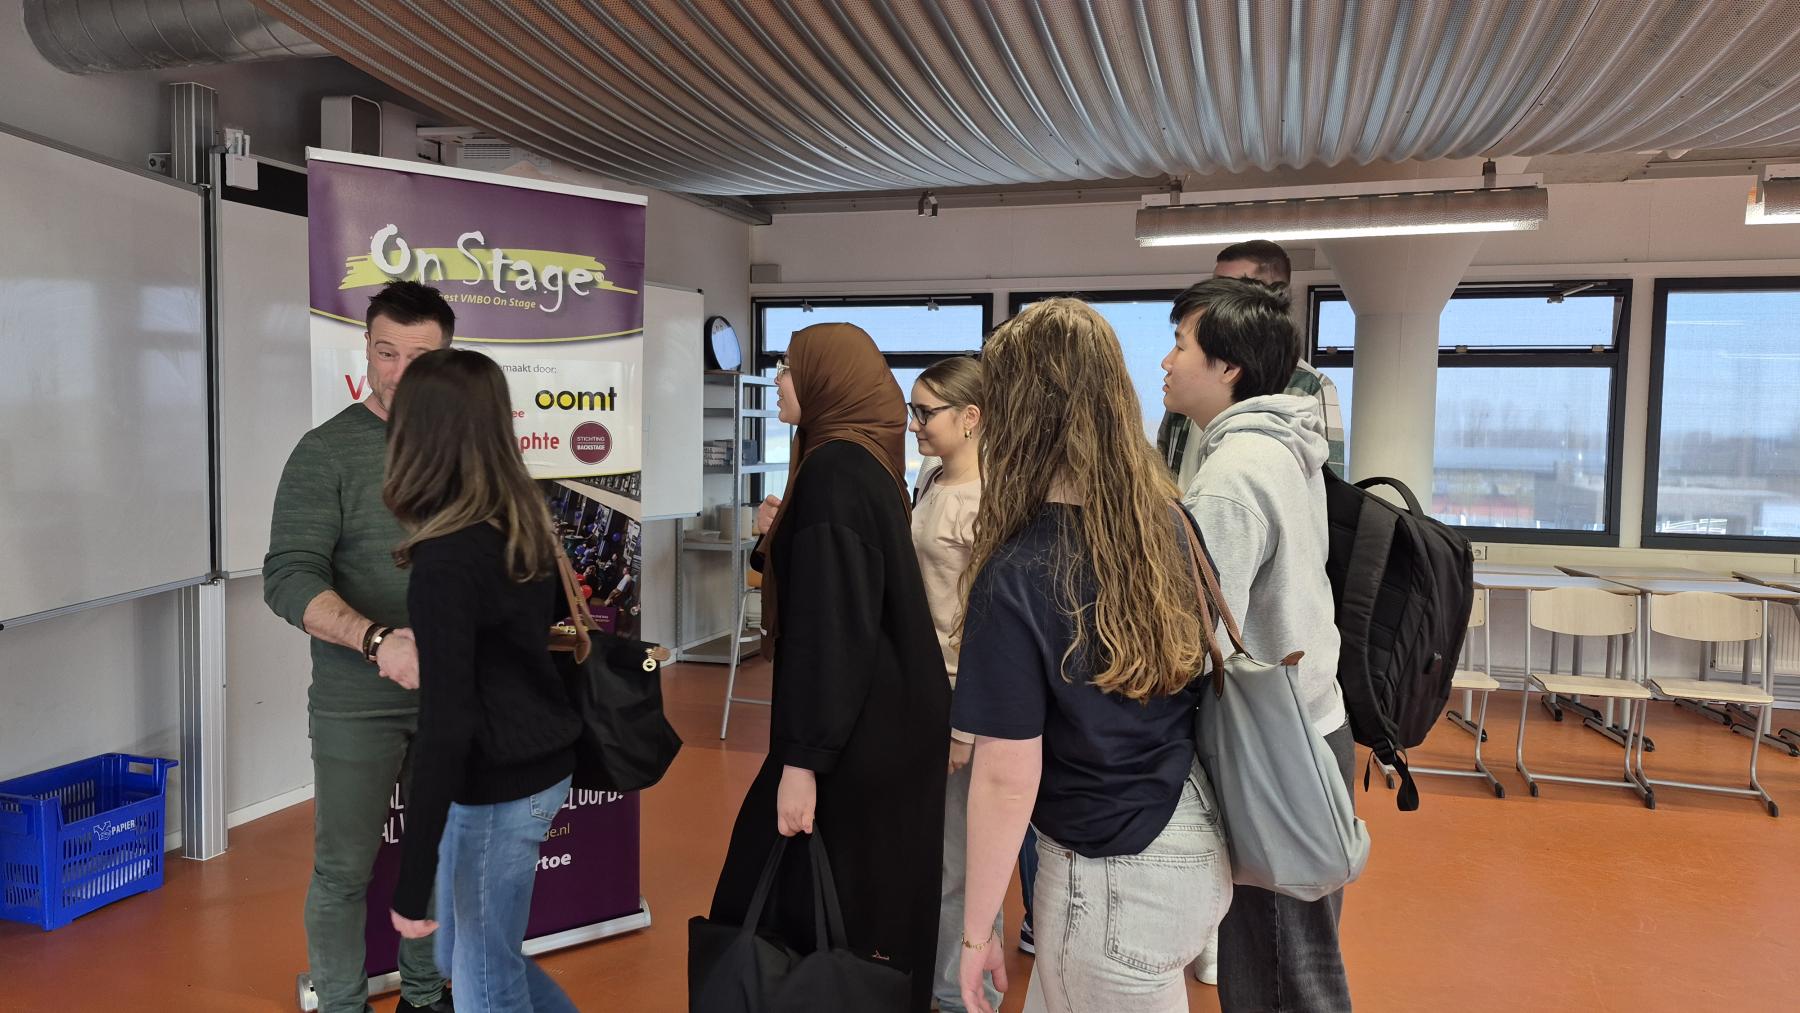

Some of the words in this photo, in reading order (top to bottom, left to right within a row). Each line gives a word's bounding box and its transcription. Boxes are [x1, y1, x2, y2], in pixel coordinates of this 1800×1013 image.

[370, 223, 443, 285] On
[438, 293, 458, 303] est
[460, 294, 491, 305] VMBO
[493, 296, 507, 306] On
[509, 297, 536, 310] Stage
[501, 363, 532, 373] maakt
[535, 387, 617, 411] oomt
[517, 432, 560, 454] phte
[111, 819, 135, 836] PAPIER
[535, 853, 572, 872] rtoe
